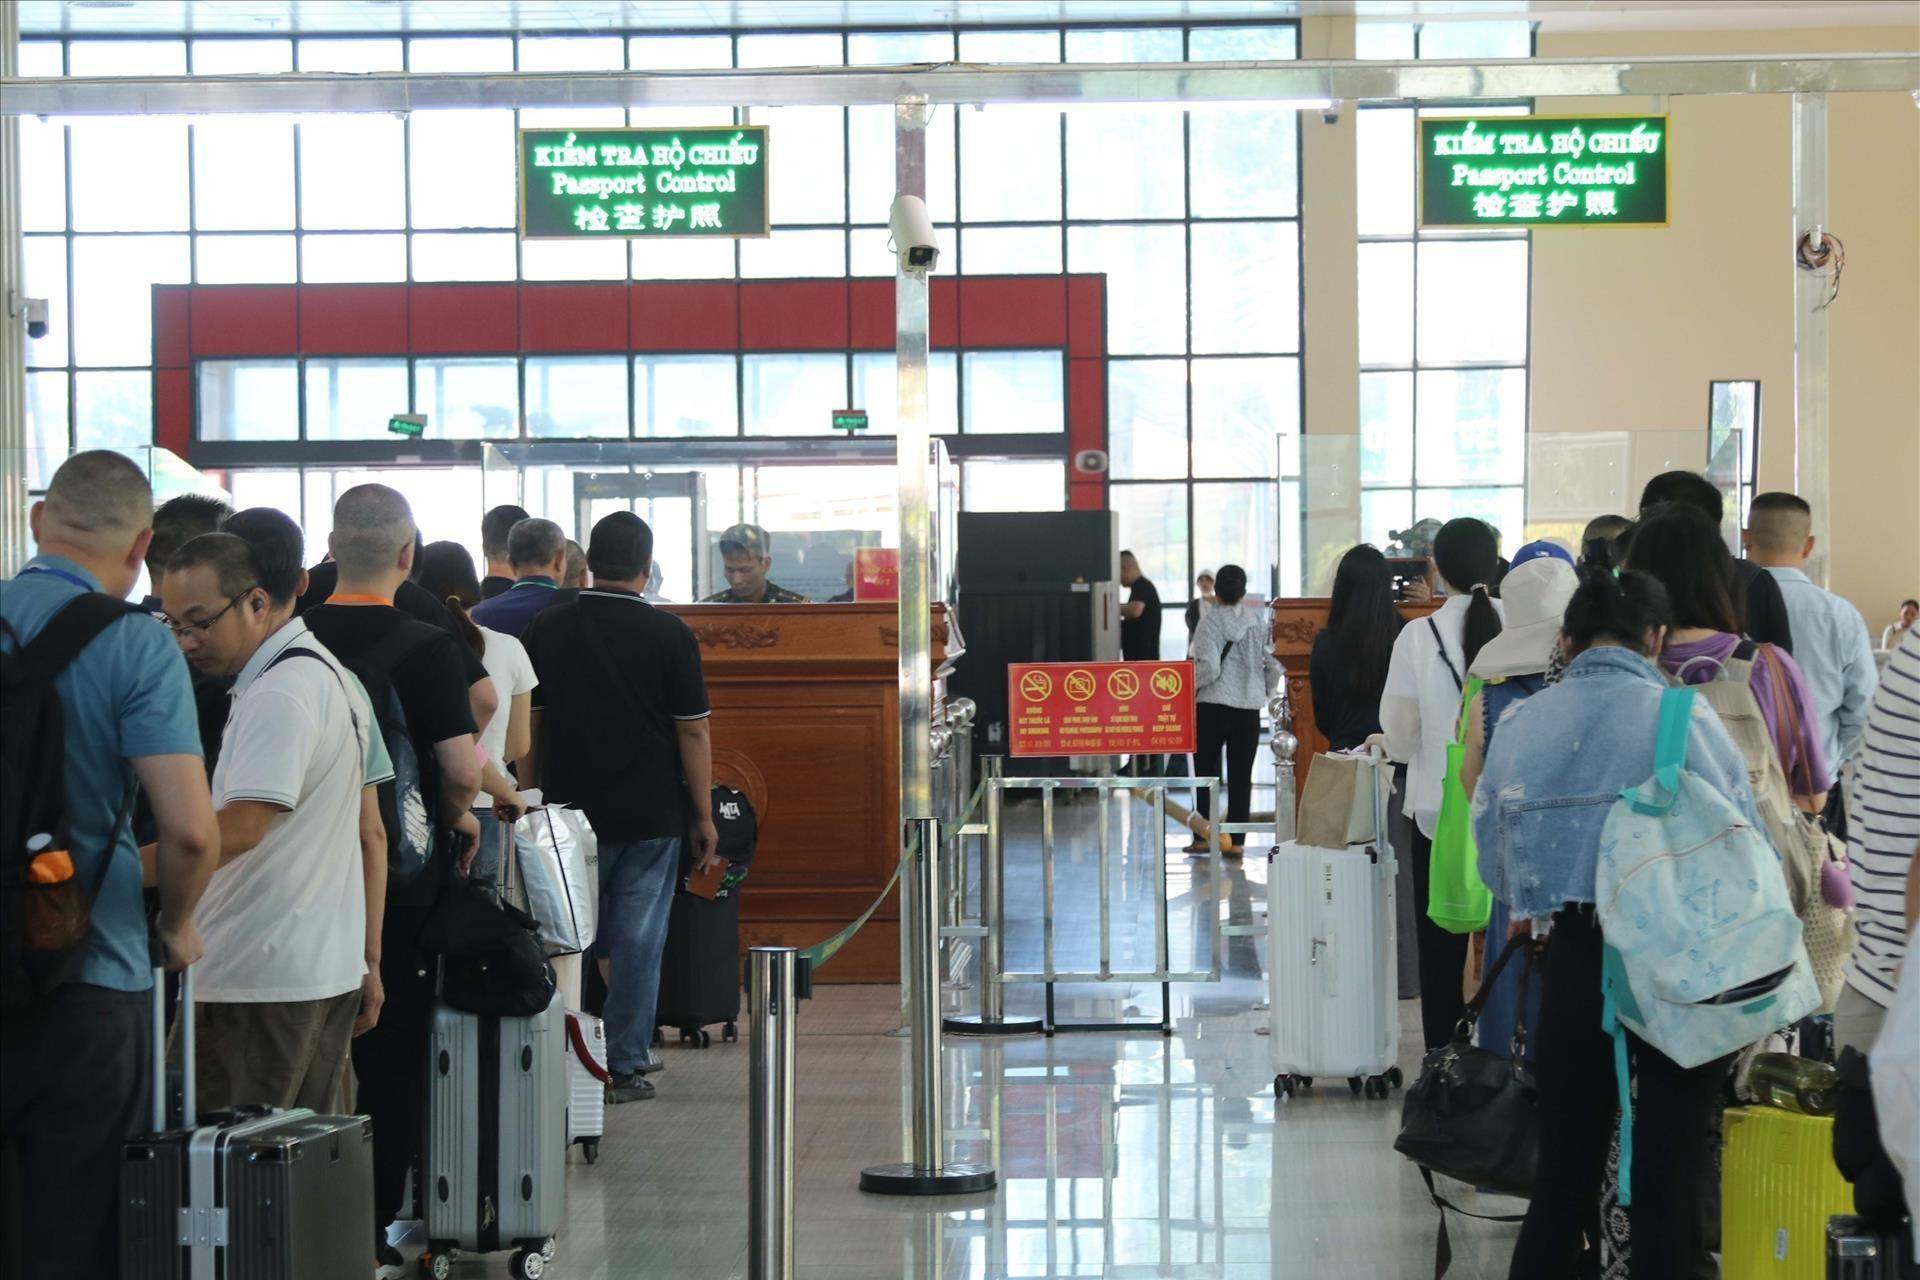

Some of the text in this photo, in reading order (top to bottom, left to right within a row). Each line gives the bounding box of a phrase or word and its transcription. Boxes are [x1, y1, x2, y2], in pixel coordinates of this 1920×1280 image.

[534, 132, 759, 171] KIỂM TRA HỘ CHIẾU
[1433, 121, 1662, 159] KIỂM TRA HỘ CHIẾU
[551, 169, 736, 200] Passport Control
[1451, 161, 1637, 191] Passport Control
[573, 202, 722, 231] 检查护照
[1472, 190, 1618, 217] 检查护照
